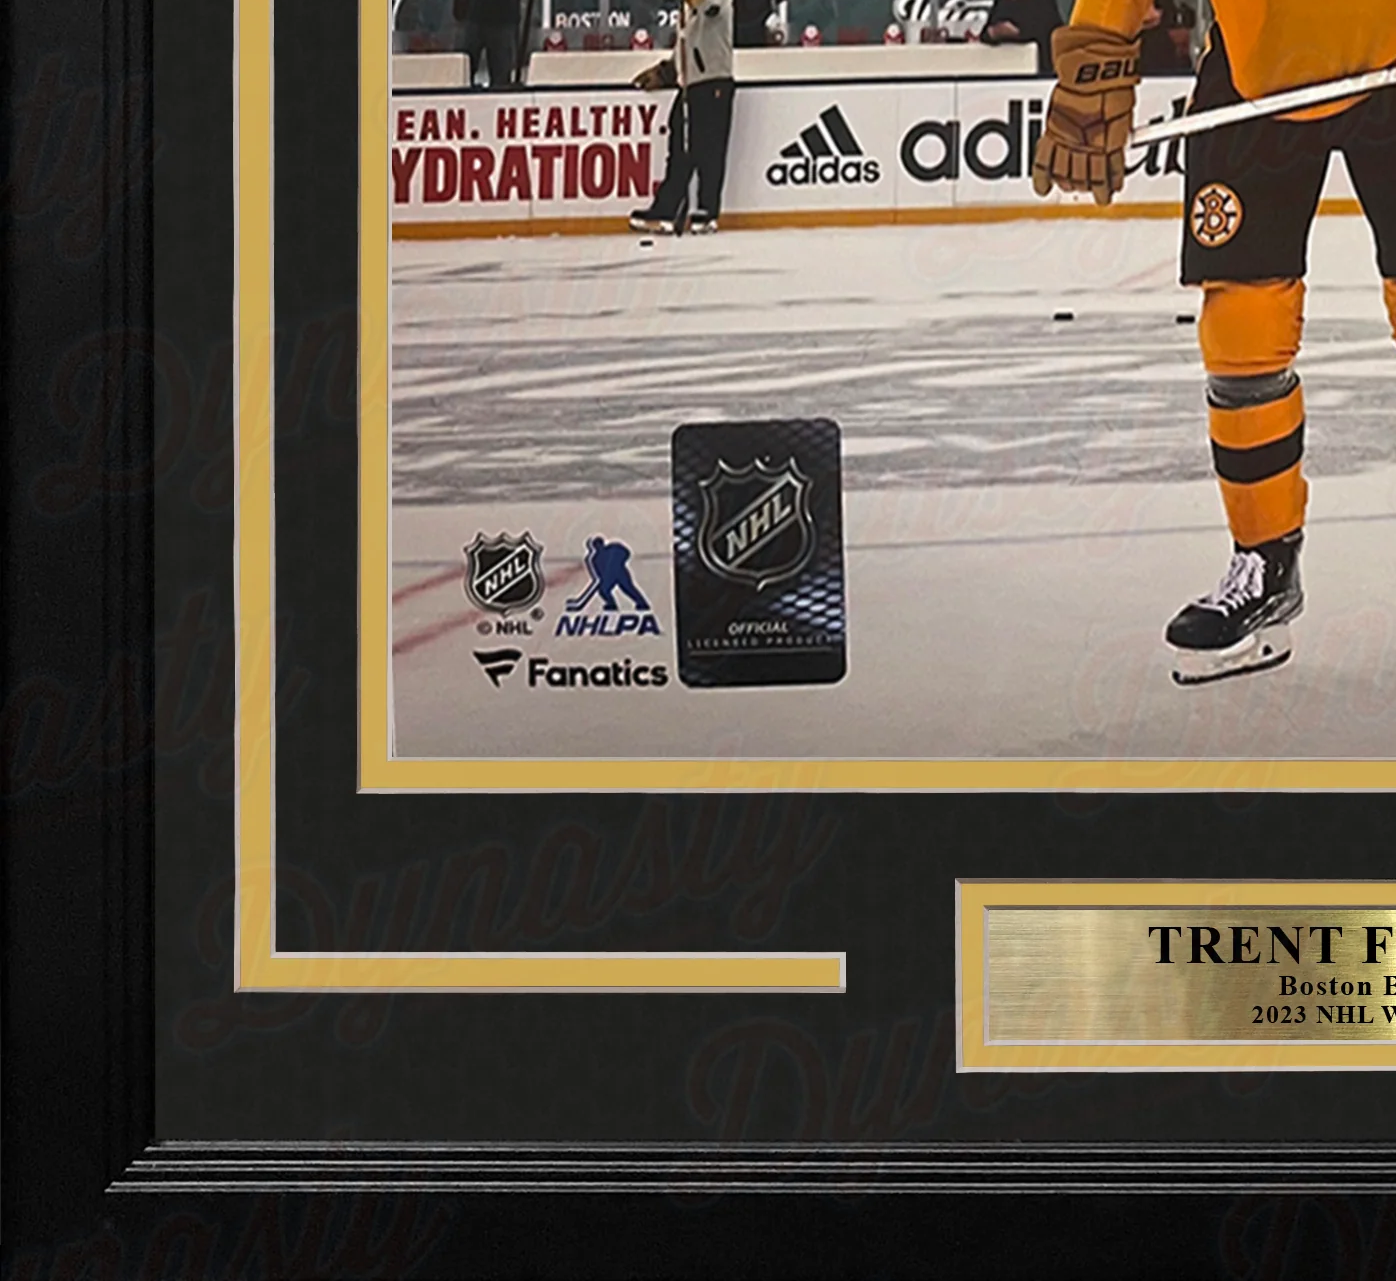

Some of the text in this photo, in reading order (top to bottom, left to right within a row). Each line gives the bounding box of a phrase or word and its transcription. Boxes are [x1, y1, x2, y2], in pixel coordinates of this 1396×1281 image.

[496, 104, 668, 140] HEALTHY.
[765, 155, 881, 186] adidas
[1148, 925, 1343, 965] TRENT
[1278, 975, 1373, 997] Boston
[1251, 1005, 1307, 1025] 2023
[1316, 1005, 1375, 1025] NHL
